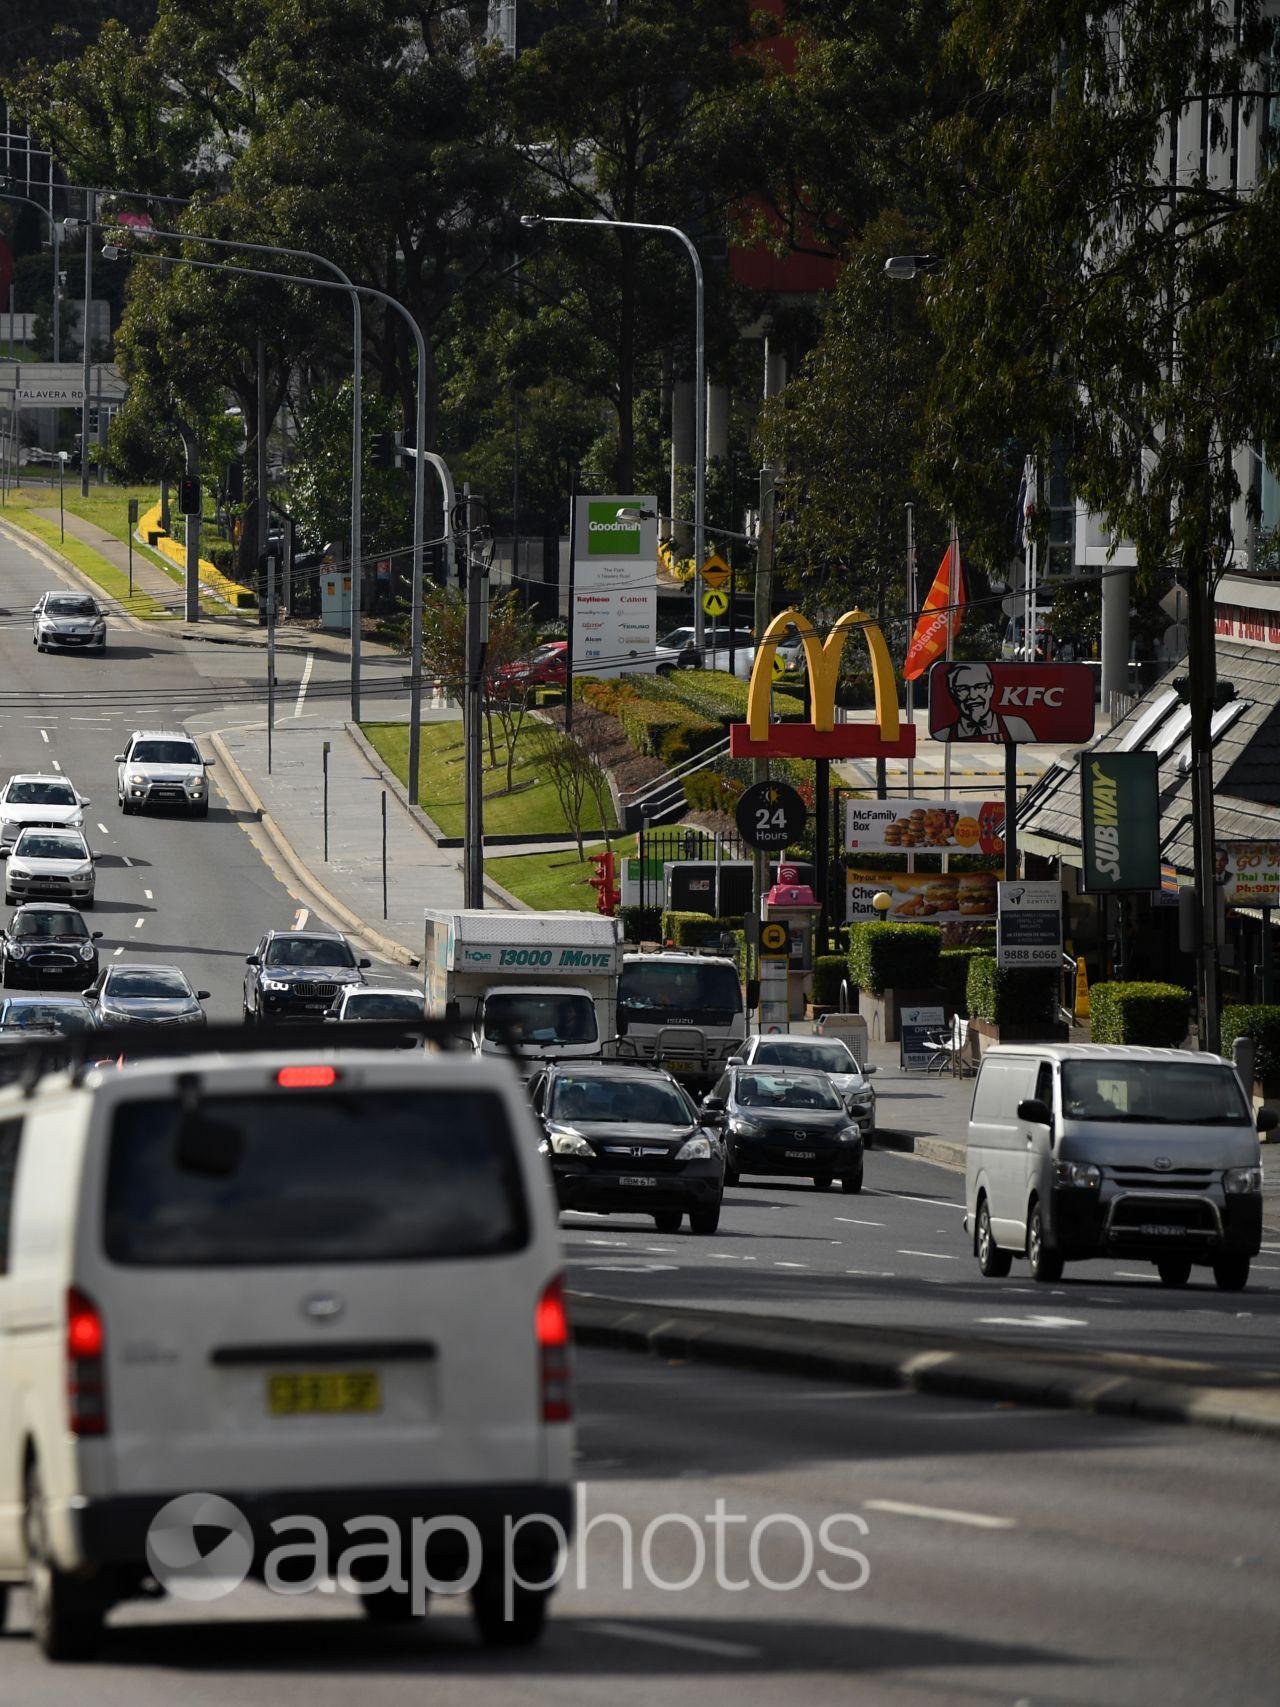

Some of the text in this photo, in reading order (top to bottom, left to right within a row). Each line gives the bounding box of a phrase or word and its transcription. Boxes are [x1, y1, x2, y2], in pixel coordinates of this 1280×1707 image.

[588, 521, 641, 531] Goodman
[998, 686, 1065, 707] KFC
[755, 808, 787, 828] 24
[853, 810, 897, 822] McFamily
[1091, 761, 1122, 882] SUBWAY
[853, 822, 870, 831] Box
[756, 831, 788, 841] Hours
[499, 949, 552, 966] 13000
[1004, 950, 1058, 960] 9888 6066
